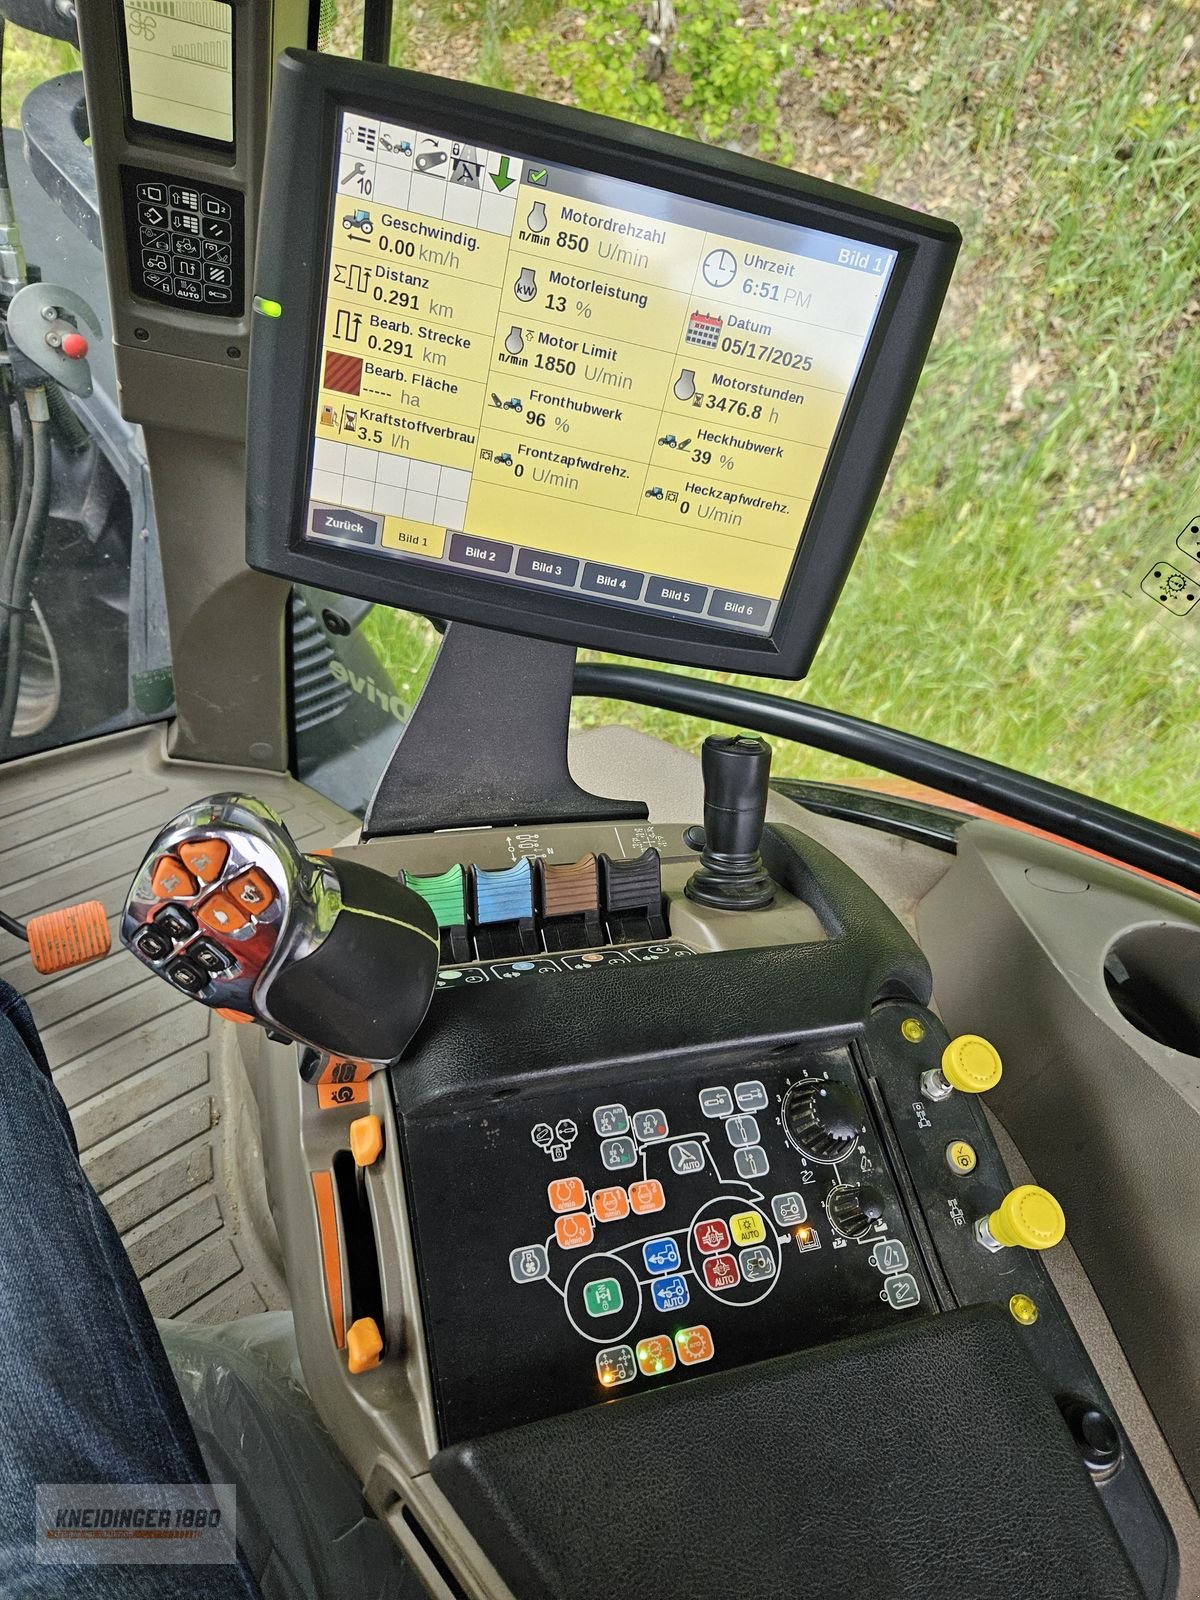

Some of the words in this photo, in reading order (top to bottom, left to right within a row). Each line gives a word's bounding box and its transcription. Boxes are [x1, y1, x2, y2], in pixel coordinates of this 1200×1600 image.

[357, 177, 372, 195] 10
[381, 214, 481, 251] Geschwindig.
[560, 206, 666, 245] Motordrehzahl
[378, 235, 415, 257] 0.00
[419, 245, 460, 269] km/h
[556, 231, 589, 253] 850
[597, 240, 649, 269] U/min
[838, 248, 868, 270] Bild
[873, 257, 883, 273] 1
[375, 264, 430, 290] Distanz
[743, 253, 796, 277] Uhrzeit
[177, 290, 200, 300] AUTO
[373, 286, 420, 311] 0.291
[429, 298, 454, 318] km
[516, 284, 535, 297] kW
[549, 270, 648, 309] Motorleistung
[742, 278, 779, 302] 6:51
[783, 287, 813, 309] PM
[545, 293, 567, 314] 13
[575, 301, 592, 319] %
[369, 315, 413, 336] Bearb.
[418, 327, 472, 350] Strecke
[727, 315, 772, 336] Datum
[368, 335, 414, 359] 0.291
[422, 347, 447, 366] km
[538, 331, 579, 353] Motor
[582, 341, 618, 363] Limit
[721, 336, 814, 373] 05/17/2025
[364, 362, 407, 383] Bearb.
[412, 373, 458, 395] Fläche
[534, 353, 577, 376] 1850
[583, 364, 633, 391] U/min
[401, 390, 421, 408] ha
[711, 373, 805, 406] Motorstunden
[529, 389, 623, 422] Fronthubwerk
[705, 394, 763, 421] 3476.8
[769, 408, 780, 424] h
[358, 426, 383, 444] 3.5
[360, 408, 476, 445] Kraftstoffverbrau
[526, 410, 546, 428] 96
[554, 416, 570, 434] %
[697, 428, 784, 459] Heckhubwerk
[517, 443, 631, 481] Frontzapfwdrehz.
[691, 448, 712, 465] 39
[719, 454, 735, 472] %
[514, 463, 524, 478] 0
[532, 468, 579, 491] U/min
[684, 481, 791, 516] Heckzapfwdrehz.
[325, 516, 364, 534] Zurück
[680, 500, 690, 515] 0
[697, 504, 743, 527] U/min
[398, 532, 420, 546] Bild
[465, 547, 486, 560] Bild
[488, 551, 496, 561] 2
[531, 560, 553, 574] Bild
[554, 565, 562, 576] 3
[596, 574, 617, 588] Bild
[618, 579, 627, 589] 4
[661, 588, 681, 601] Bild
[682, 593, 690, 603] 5
[724, 601, 744, 614] Bild
[745, 605, 753, 616] 6
[682, 1161, 700, 1171] AUTO
[650, 1182, 657, 1193] 2
[741, 1229, 760, 1240] AUTO
[715, 1273, 735, 1285] AUTO
[663, 1296, 684, 1308] AUTO
